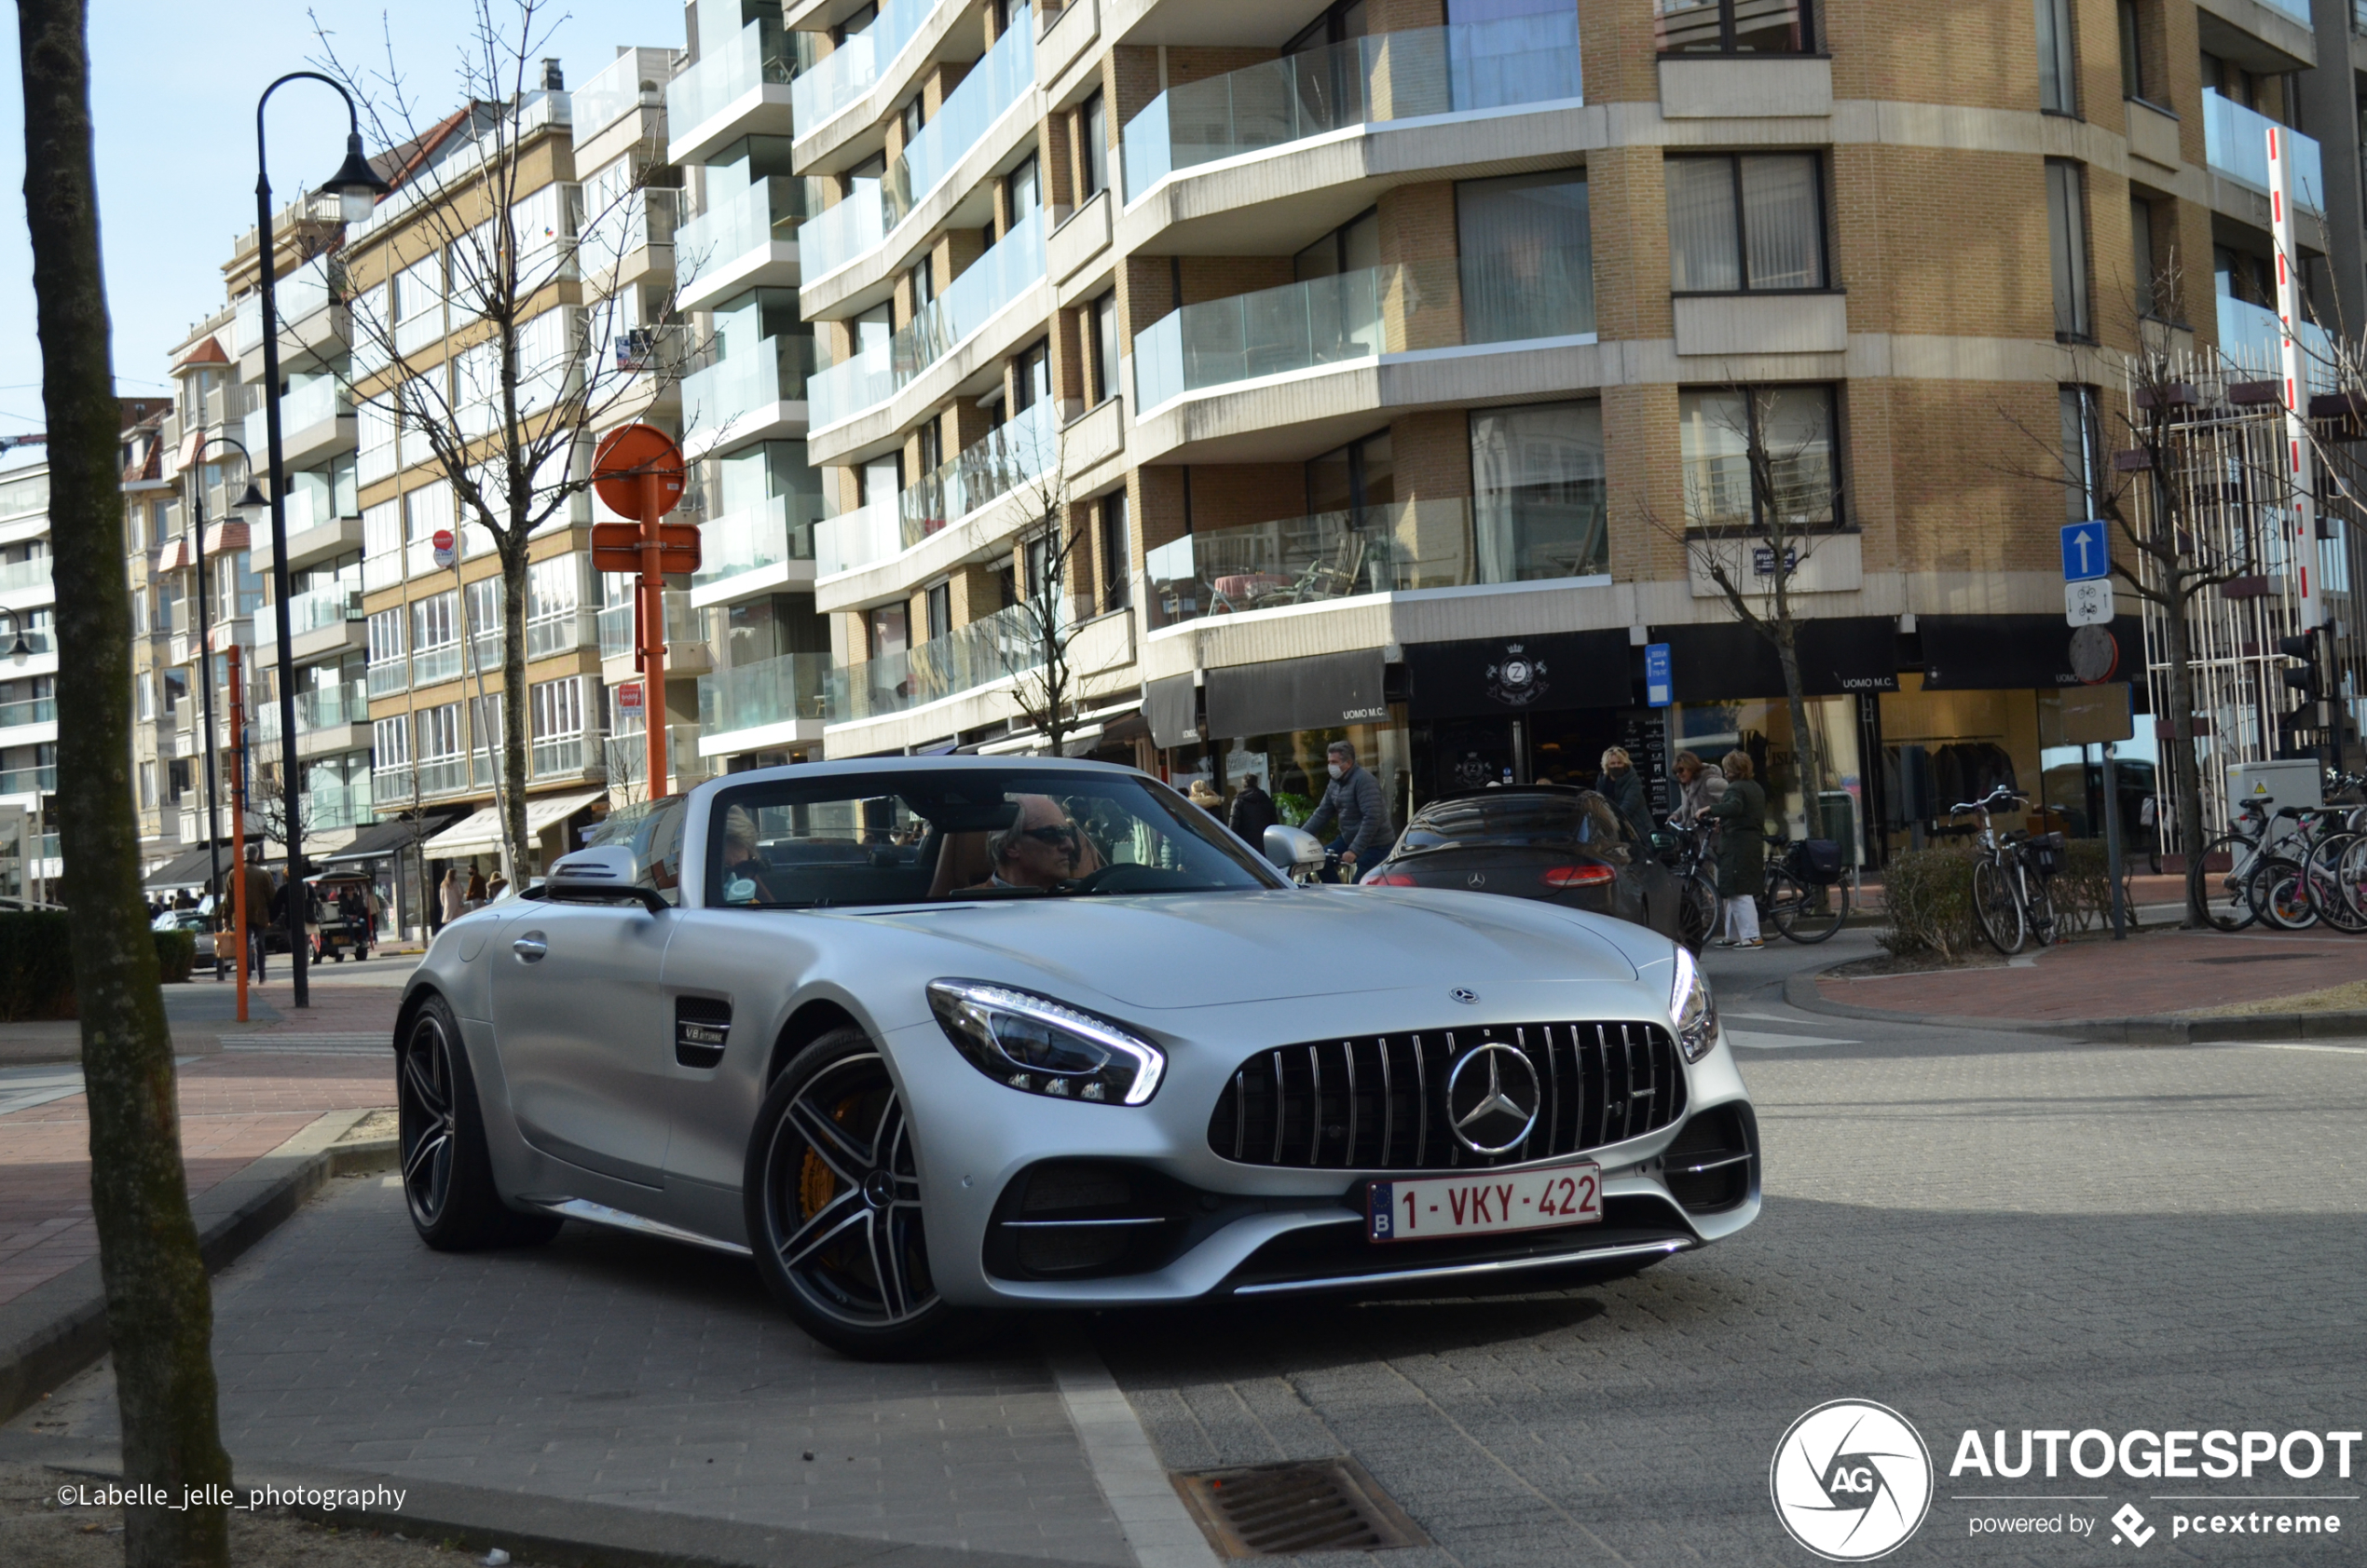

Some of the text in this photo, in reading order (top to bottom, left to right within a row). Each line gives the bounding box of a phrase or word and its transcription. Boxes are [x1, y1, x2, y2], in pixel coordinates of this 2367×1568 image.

[1511, 665, 1523, 679] Z
[2056, 674, 2078, 683] UOMO
[1842, 677, 1894, 689] UOMO M.C.
[1343, 706, 1385, 720] UOMO M.C.
[686, 1028, 699, 1039] V8
[1402, 1175, 1597, 1230] 1-VKY-422
[1375, 1214, 1390, 1232] B
